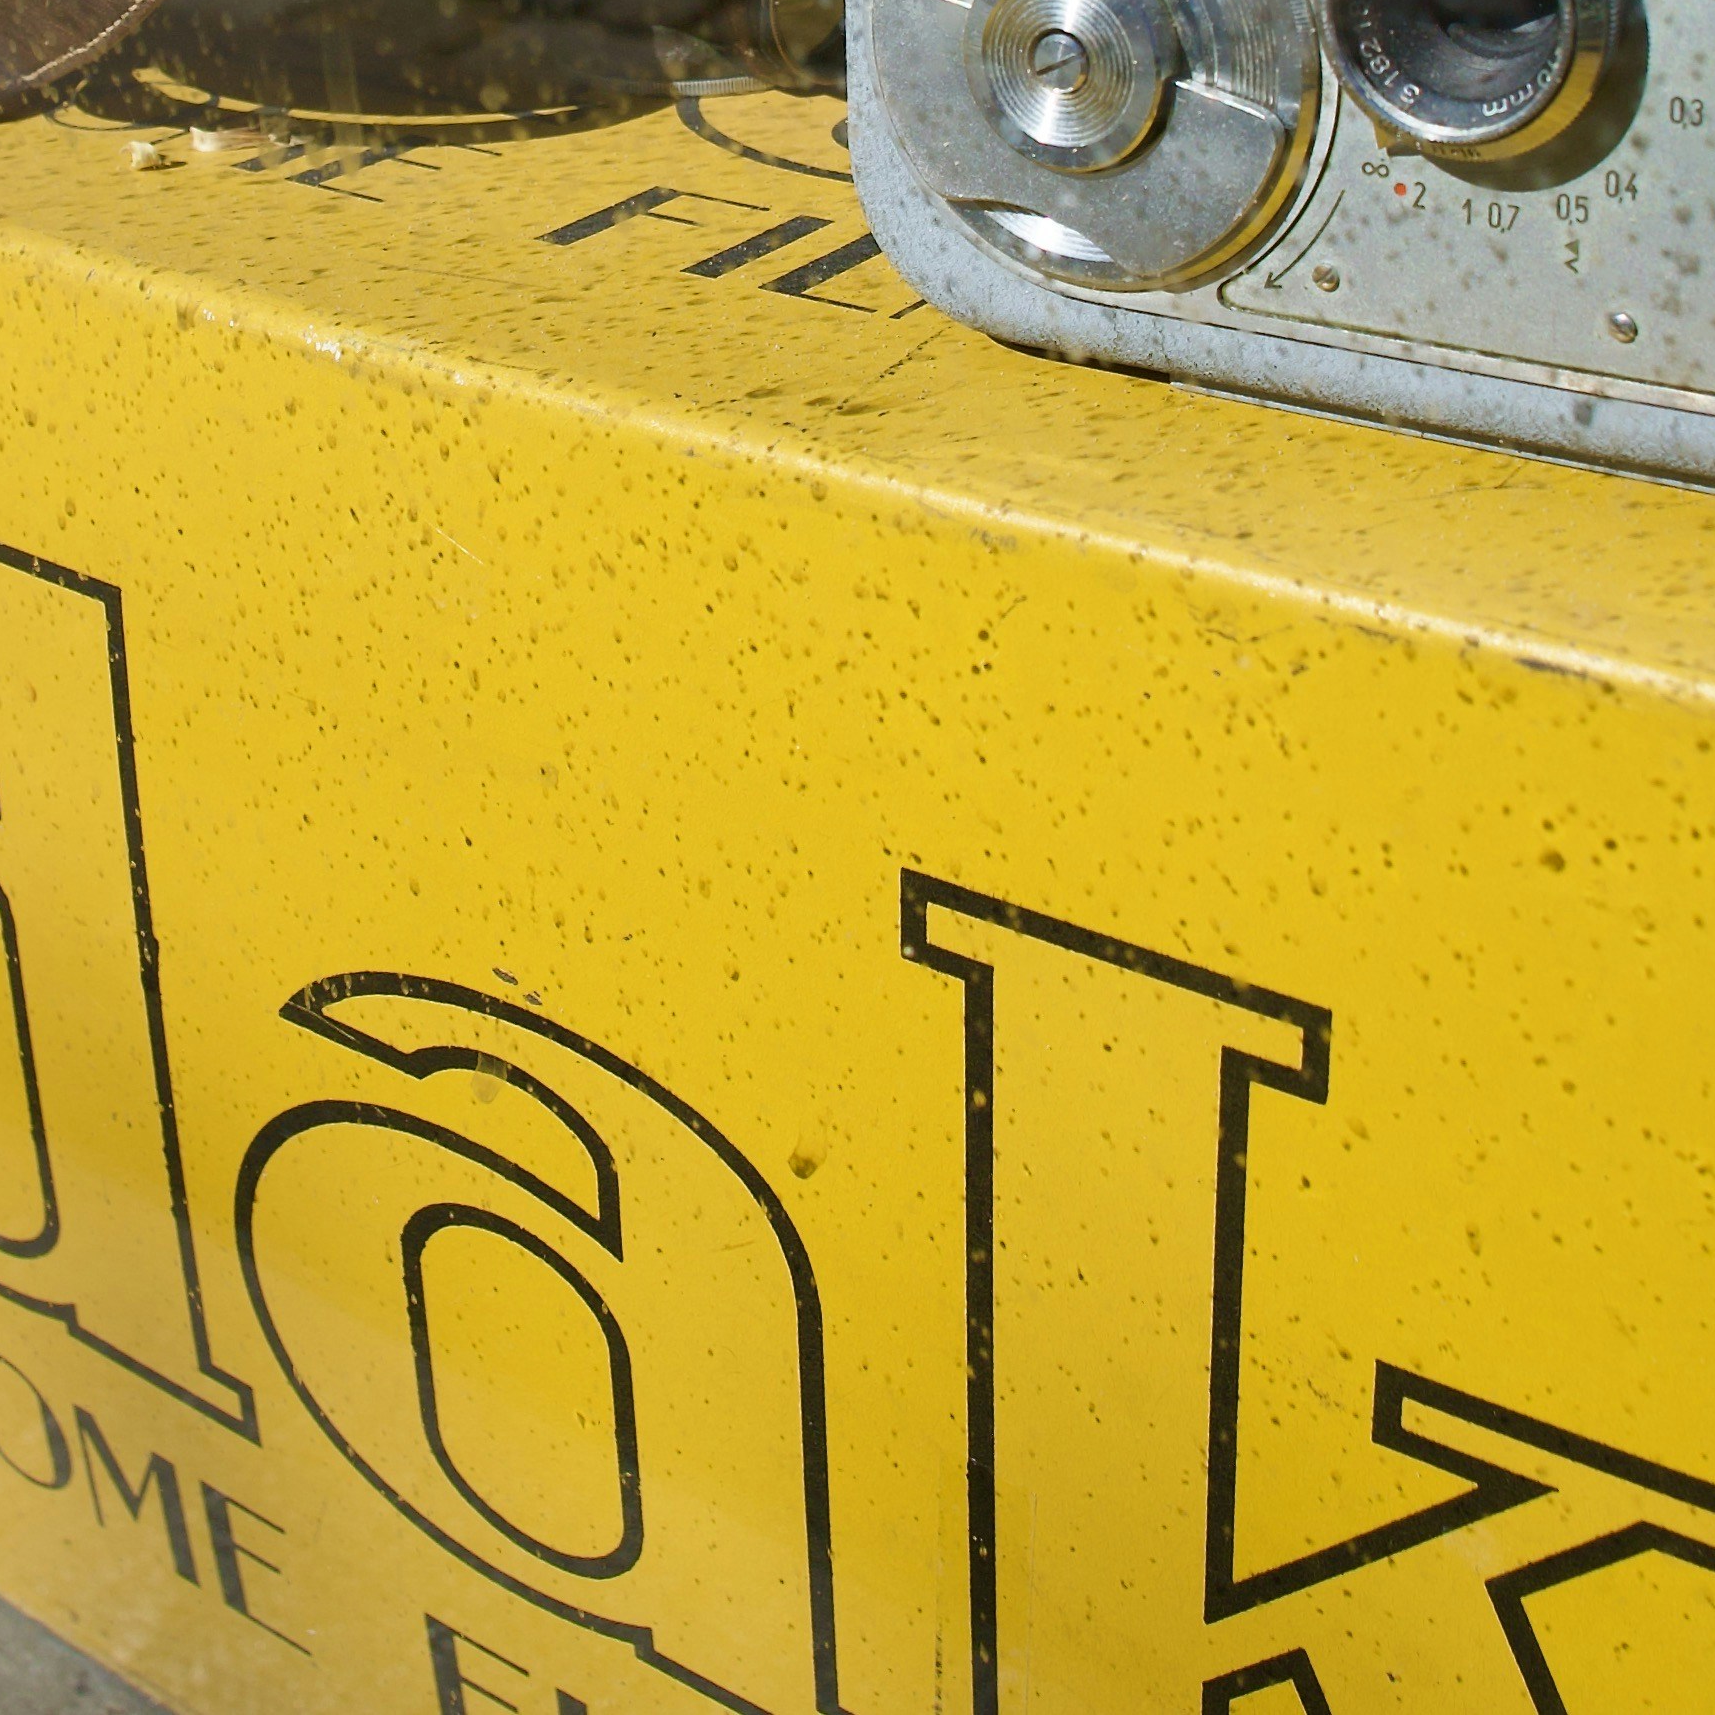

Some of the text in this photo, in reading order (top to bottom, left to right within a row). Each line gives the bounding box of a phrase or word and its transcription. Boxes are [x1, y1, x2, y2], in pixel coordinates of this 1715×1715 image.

[1668, 95, 1704, 131] 0,3
[1412, 181, 1427, 210] 2
[1604, 169, 1638, 203] 0,4
[1460, 198, 1473, 226] 1
[1487, 201, 1521, 234] 0,7
[1555, 192, 1589, 225] 0,5
[534, 186, 928, 320] FIL
